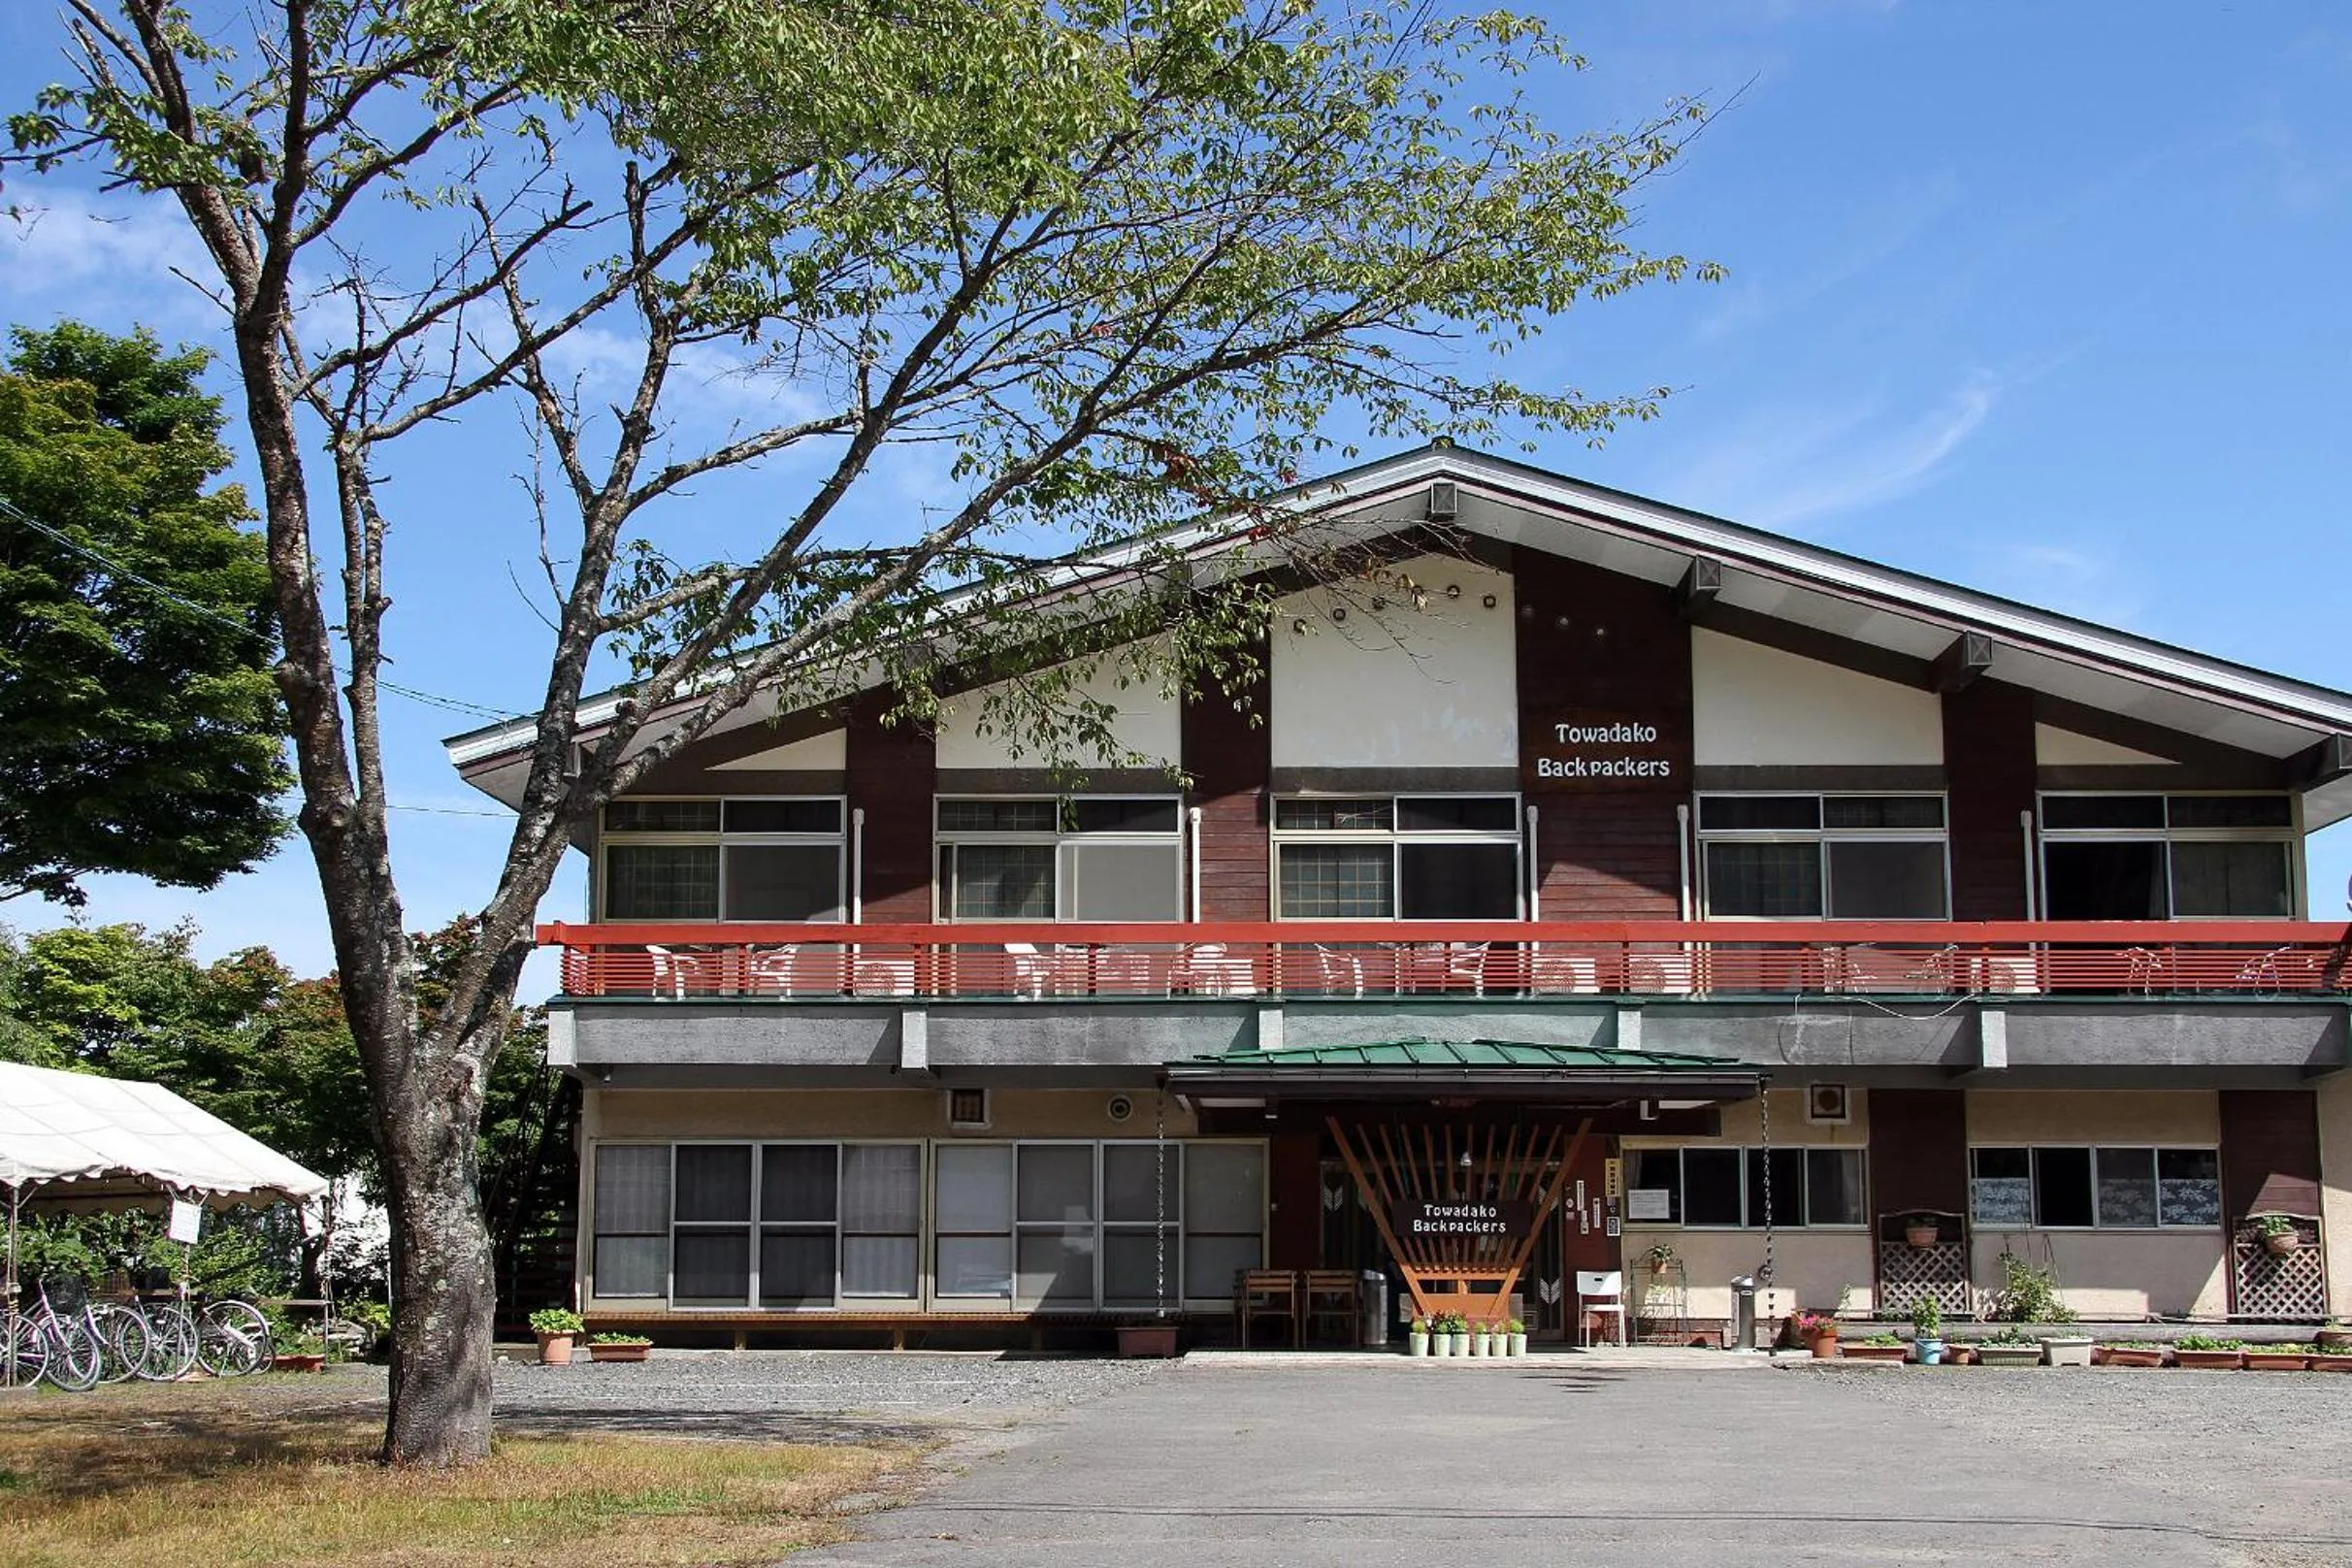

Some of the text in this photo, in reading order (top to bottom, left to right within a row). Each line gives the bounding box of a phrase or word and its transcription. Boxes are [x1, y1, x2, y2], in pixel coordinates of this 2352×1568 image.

[1554, 722, 1657, 744] Towadako
[1537, 756, 1671, 777] Backpackers
[1422, 1203, 1497, 1218] Towadako
[1413, 1219, 1507, 1233] Backpackers
